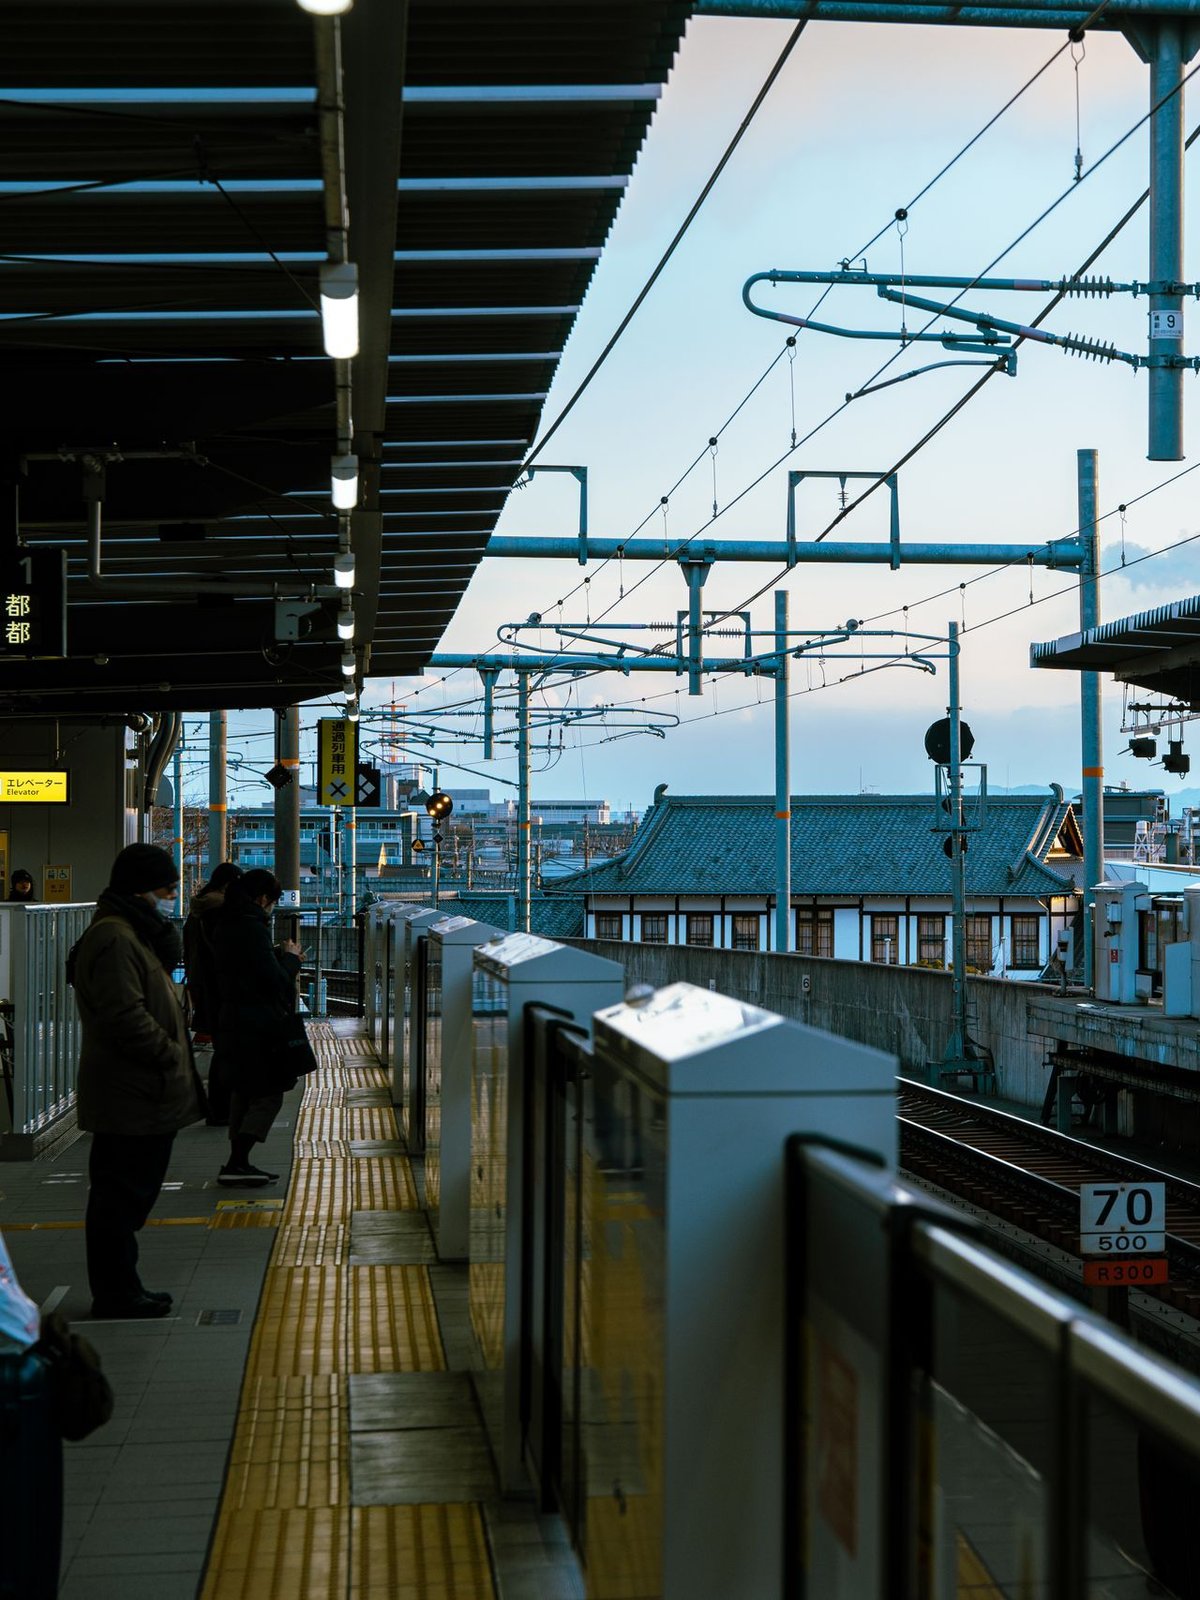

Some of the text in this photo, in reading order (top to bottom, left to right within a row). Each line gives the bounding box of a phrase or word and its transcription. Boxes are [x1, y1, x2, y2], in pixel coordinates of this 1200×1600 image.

[1167, 314, 1175, 328] 9
[19, 557, 32, 584] 1
[5, 594, 30, 617] 都
[5, 621, 30, 644] 都
[331, 721, 345, 774] 通過列車用
[7, 779, 63, 788] エレベーター
[7, 788, 39, 796] Elevator
[290, 891, 296, 902] 8
[803, 978, 810, 989] 6
[1092, 1188, 1153, 1226] 70
[1098, 1235, 1147, 1251] 500
[1098, 1264, 1154, 1281] R300
